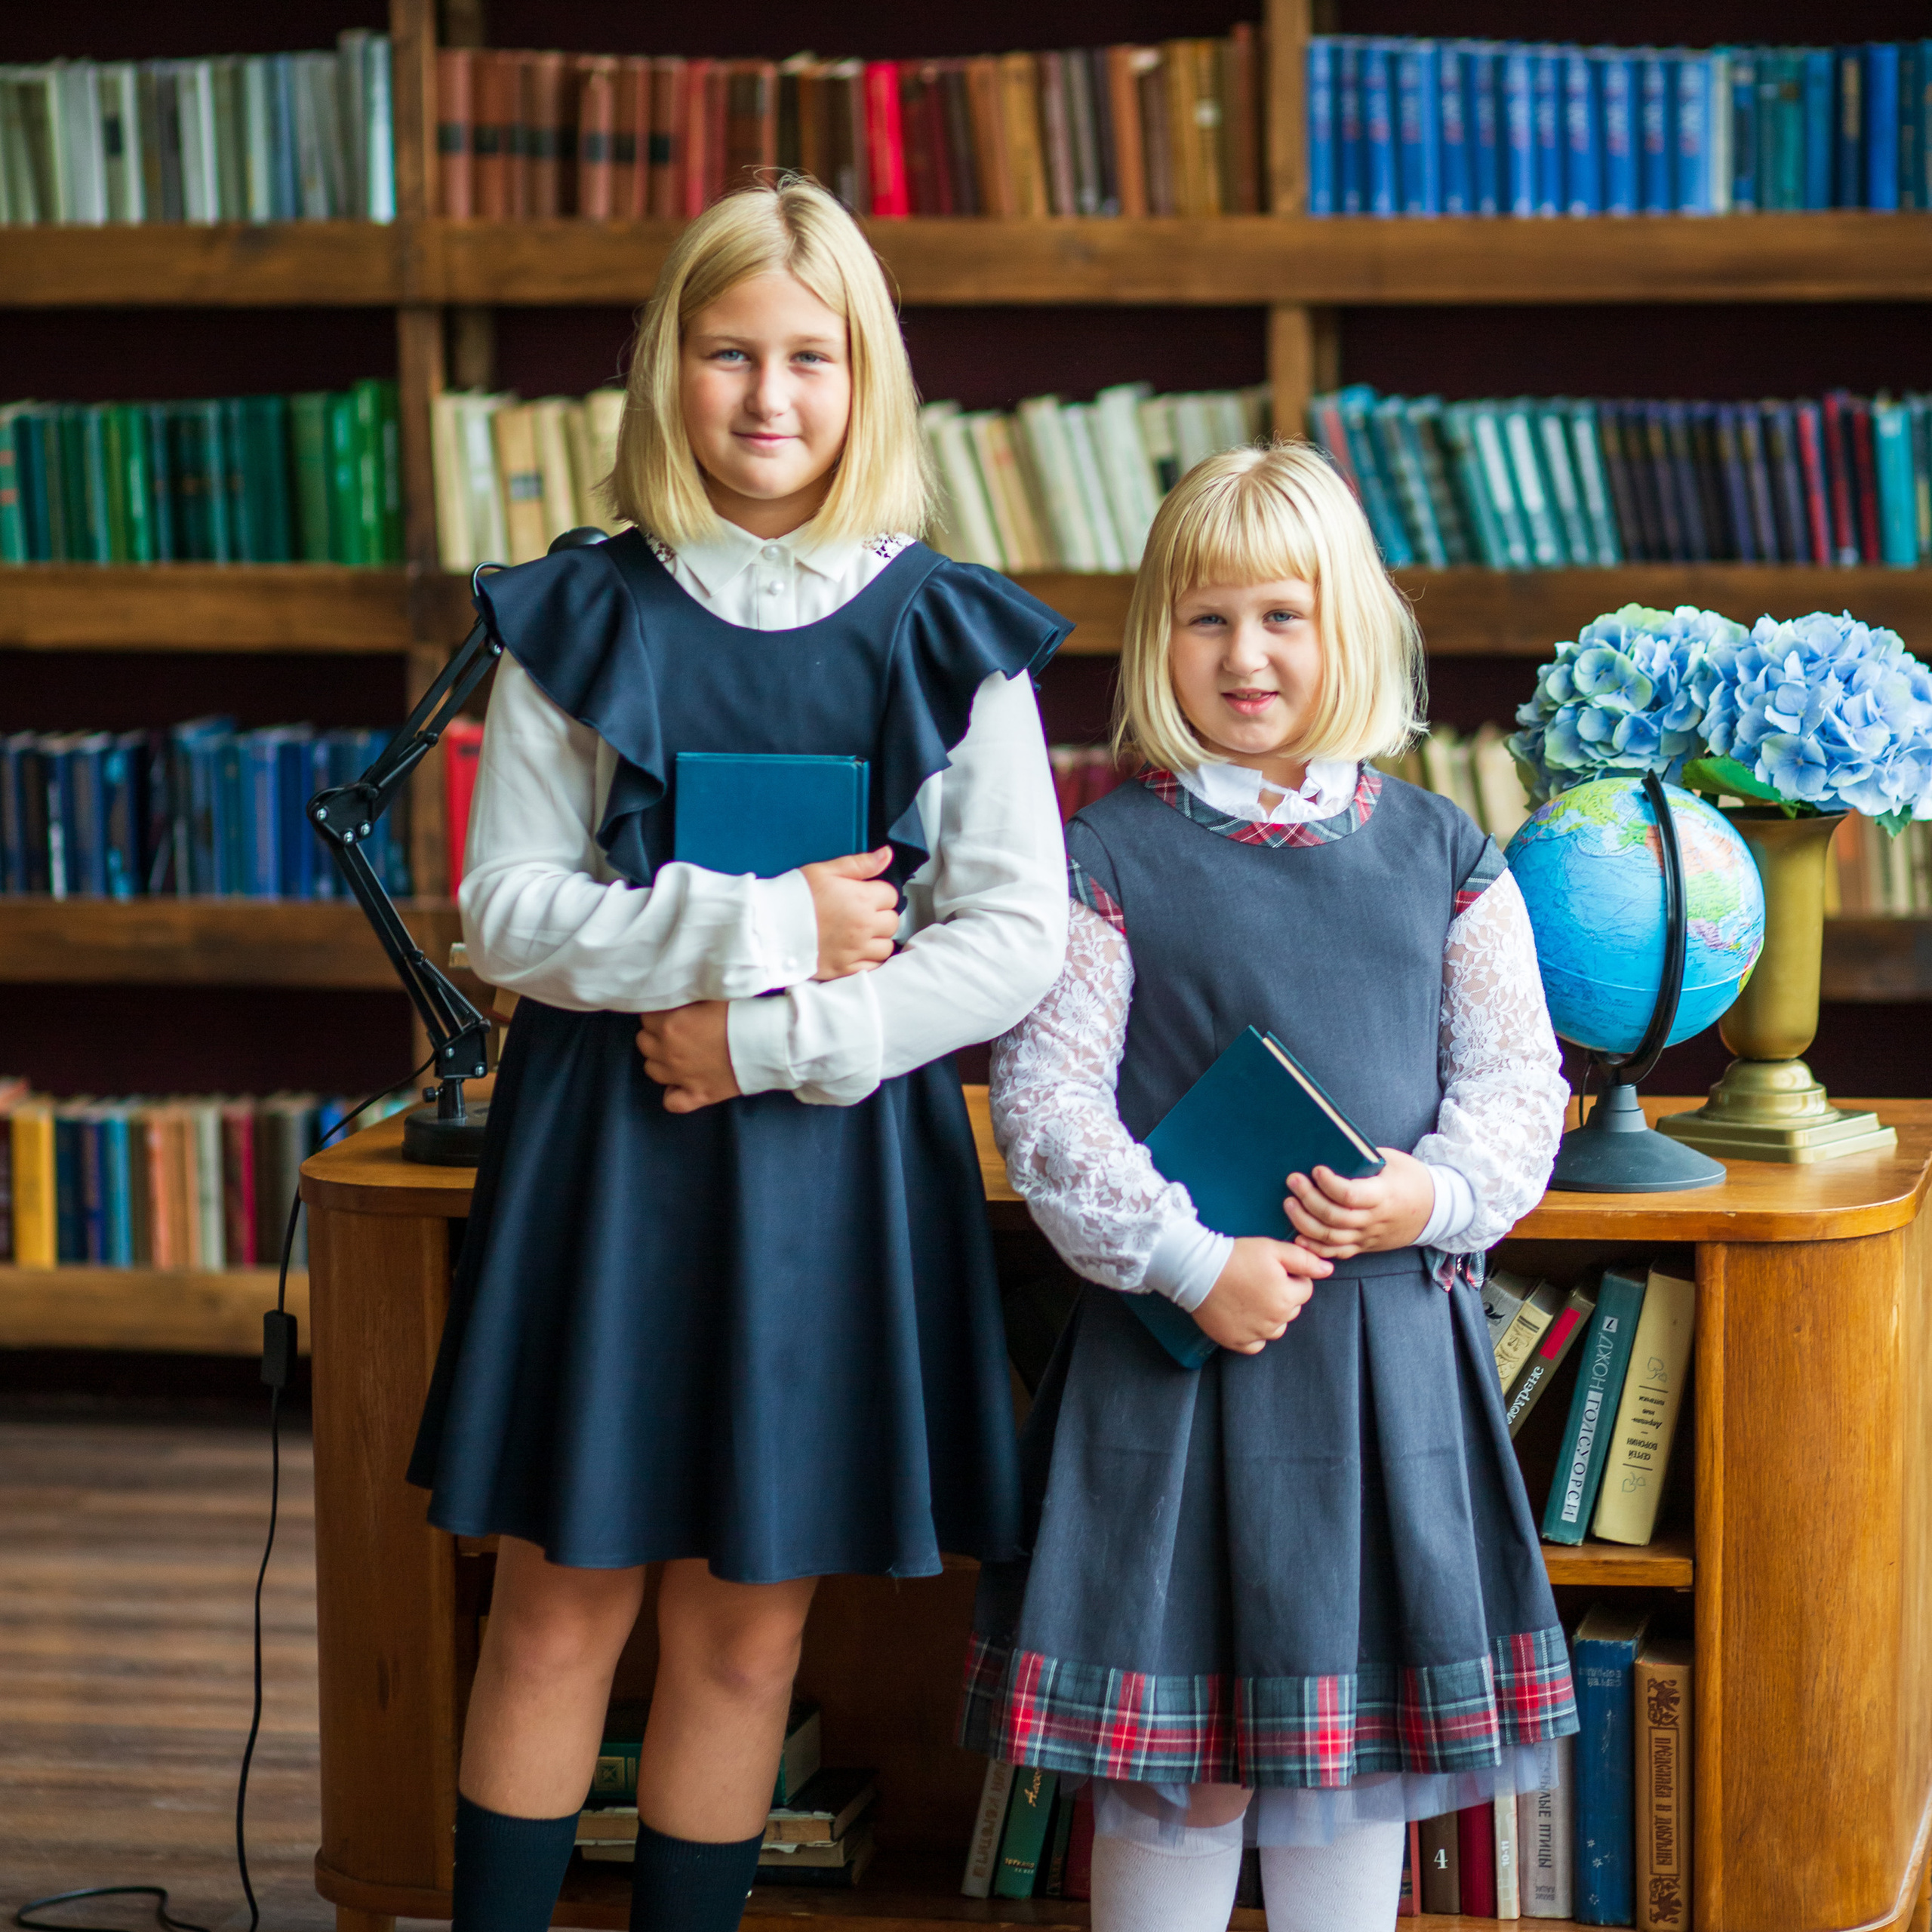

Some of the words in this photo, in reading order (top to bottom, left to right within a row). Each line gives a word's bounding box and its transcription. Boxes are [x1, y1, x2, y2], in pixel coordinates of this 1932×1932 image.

[1589, 1332, 1614, 1391] ДЖОН
[1626, 1437, 1658, 1451] ВОРОНИН
[1628, 1450, 1651, 1461] СЕРГЕЙ
[1564, 1398, 1602, 1517] ГОЛСУОРСИ
[1433, 1848, 1449, 1870] 4
[1501, 1840, 1510, 1866] 10-11
[1538, 1823, 1551, 1869] ПТИЦЫ
